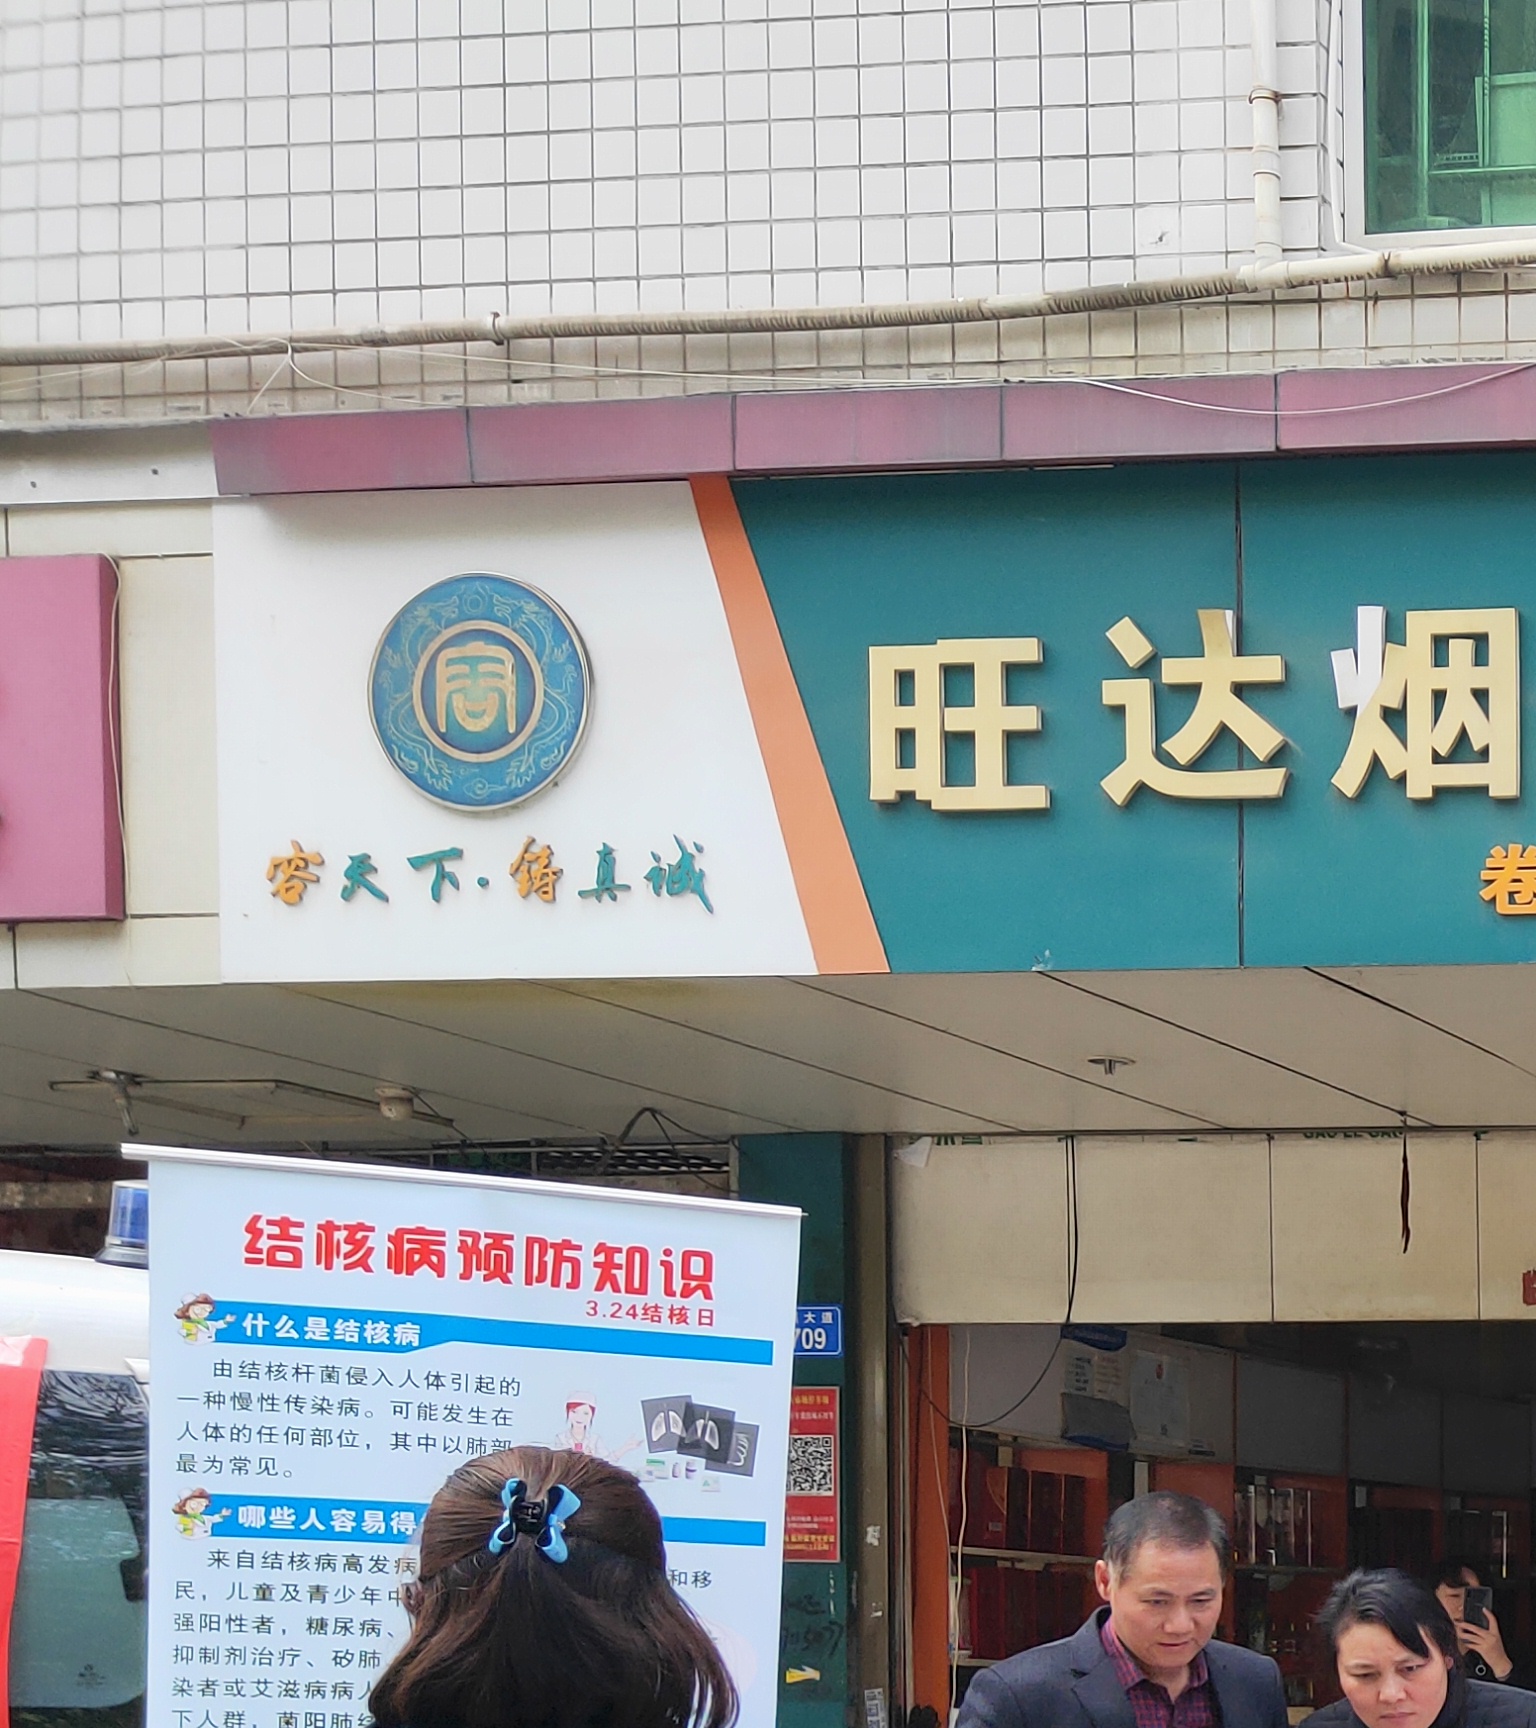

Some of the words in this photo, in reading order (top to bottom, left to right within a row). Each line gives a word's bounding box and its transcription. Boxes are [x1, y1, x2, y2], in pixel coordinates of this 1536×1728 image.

[243, 1213, 715, 1301] 结核病预防知识
[242, 1312, 421, 1347] 什么是结核病
[585, 1300, 714, 1327] 3.24结核日
[796, 1311, 833, 1324] 大道
[213, 1358, 521, 1398] 由结核杆菌侵入人体引起的
[176, 1390, 515, 1428] 一种慢性传染病。可能发生在
[175, 1452, 295, 1479] 最为常见。
[237, 1505, 422, 1536] 哪些人容易得
[207, 1549, 417, 1576] 来自结核病高发病
[668, 1569, 713, 1589] 和移
